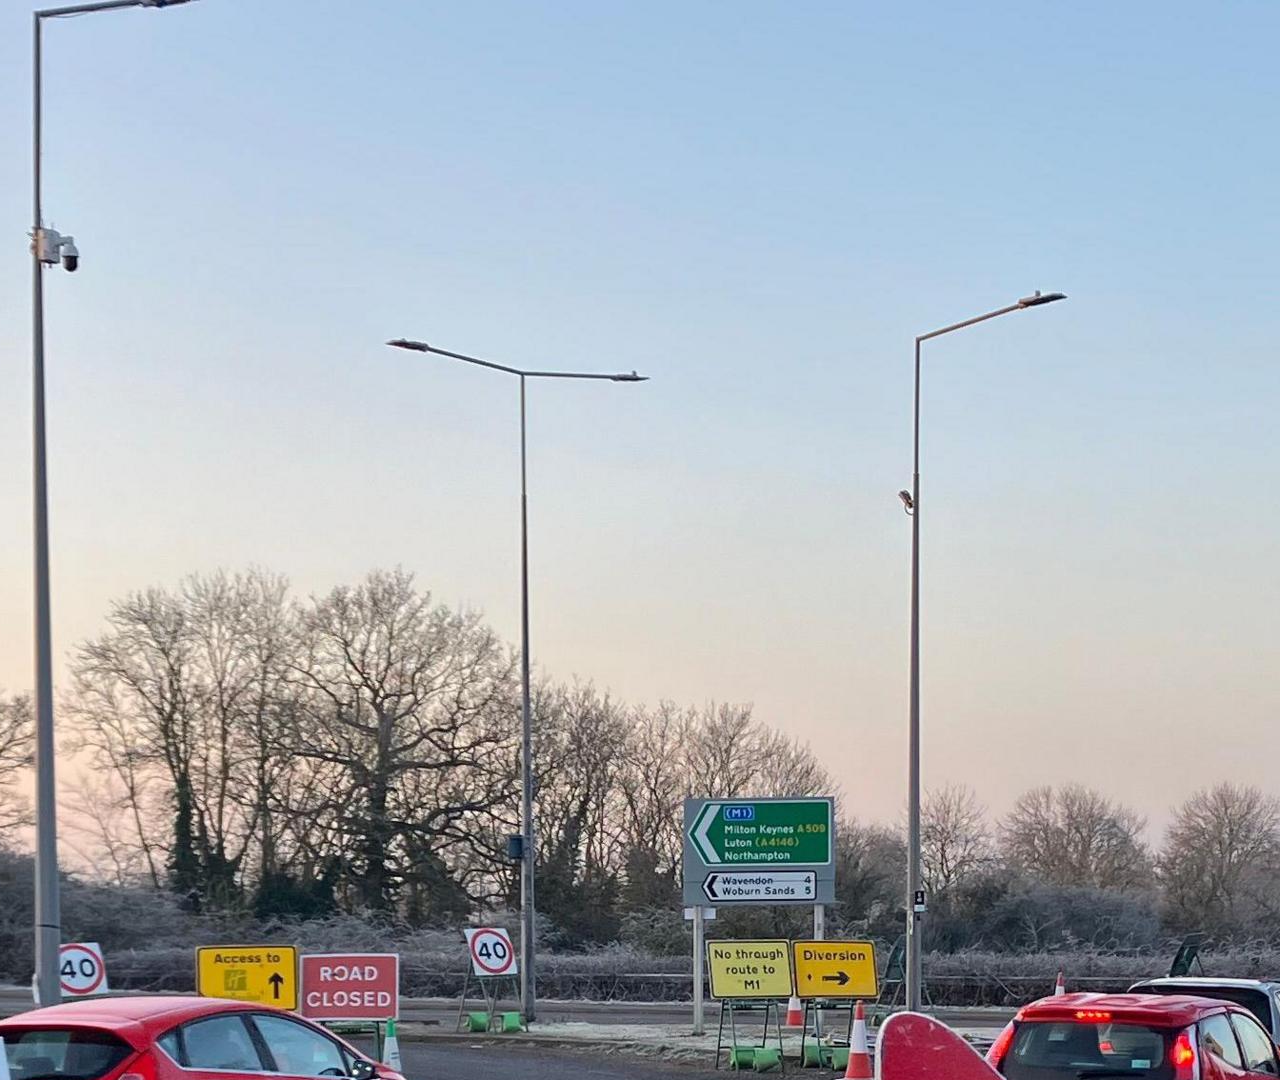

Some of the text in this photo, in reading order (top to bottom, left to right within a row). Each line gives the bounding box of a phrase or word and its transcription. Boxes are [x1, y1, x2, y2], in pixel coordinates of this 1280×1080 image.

[726, 808, 753, 819] (M1)
[724, 823, 826, 836] Milton Keynes A509
[724, 836, 800, 848] Luton (A4146)
[724, 851, 791, 862] Northampton
[721, 876, 811, 885] Wavendon 4
[722, 886, 811, 895] Woburn Sands 5
[478, 942, 507, 960] 40
[714, 948, 784, 962] No through
[803, 950, 866, 961] Diversion
[214, 952, 281, 964] Access to
[61, 958, 96, 979] 40
[319, 966, 378, 982] ROAD
[726, 965, 776, 974] route to
[744, 979, 761, 990] M1
[306, 991, 392, 1007] CLOSED
